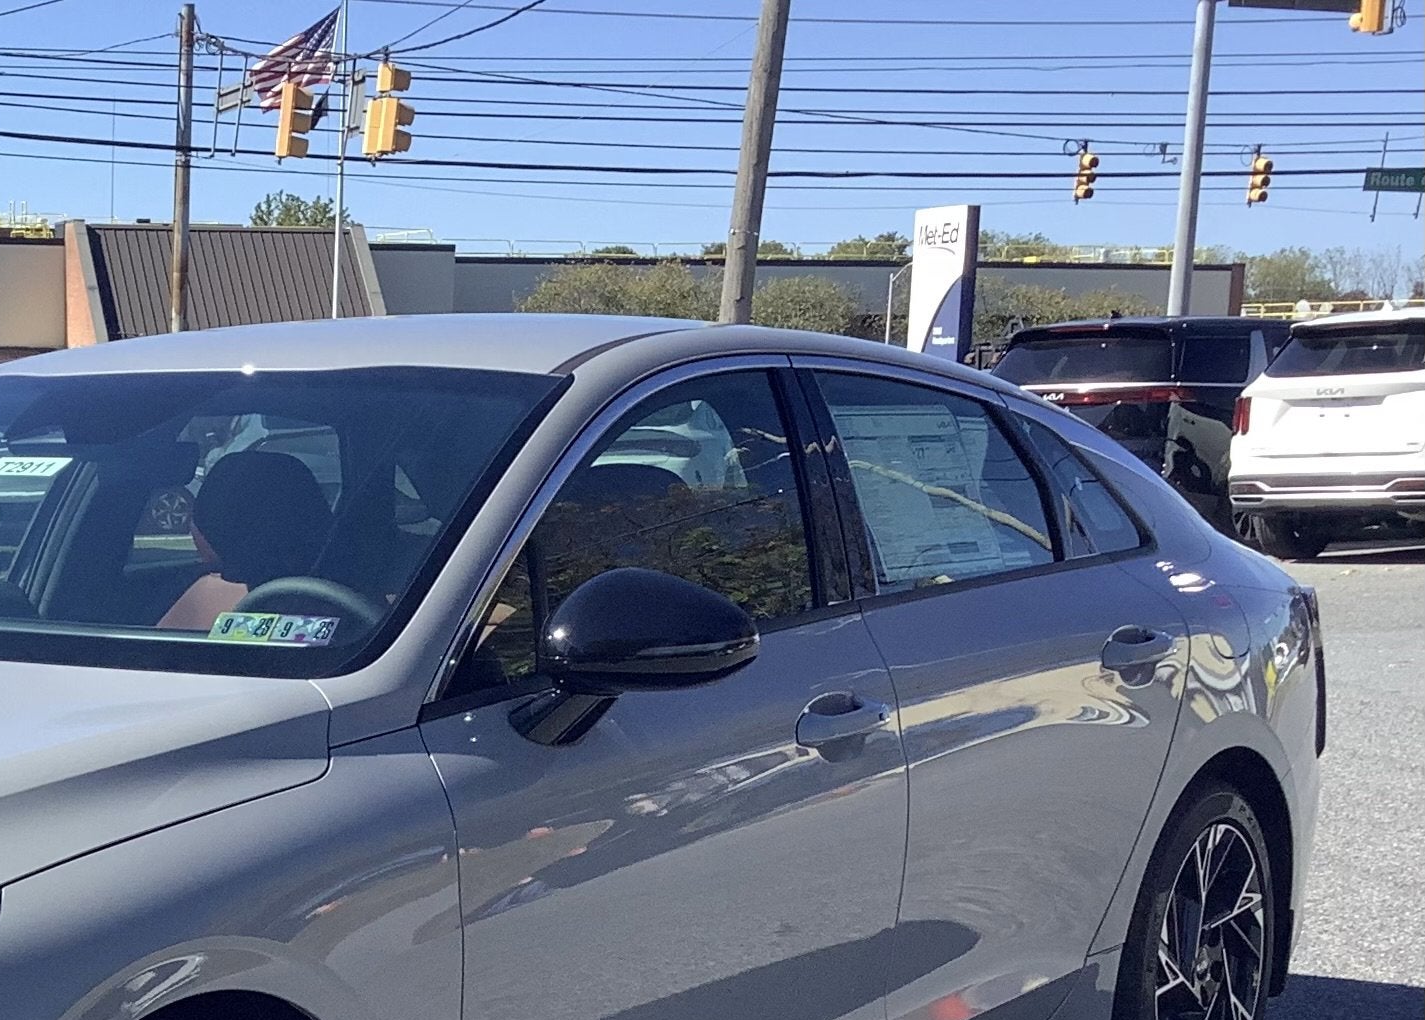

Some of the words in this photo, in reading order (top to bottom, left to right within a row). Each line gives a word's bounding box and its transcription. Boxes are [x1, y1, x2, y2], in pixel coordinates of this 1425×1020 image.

[1370, 172, 1415, 187] Route
[919, 222, 960, 246] Met-Ed
[1316, 388, 1345, 396] KIA
[221, 618, 234, 634] 9
[280, 621, 293, 638] 9
